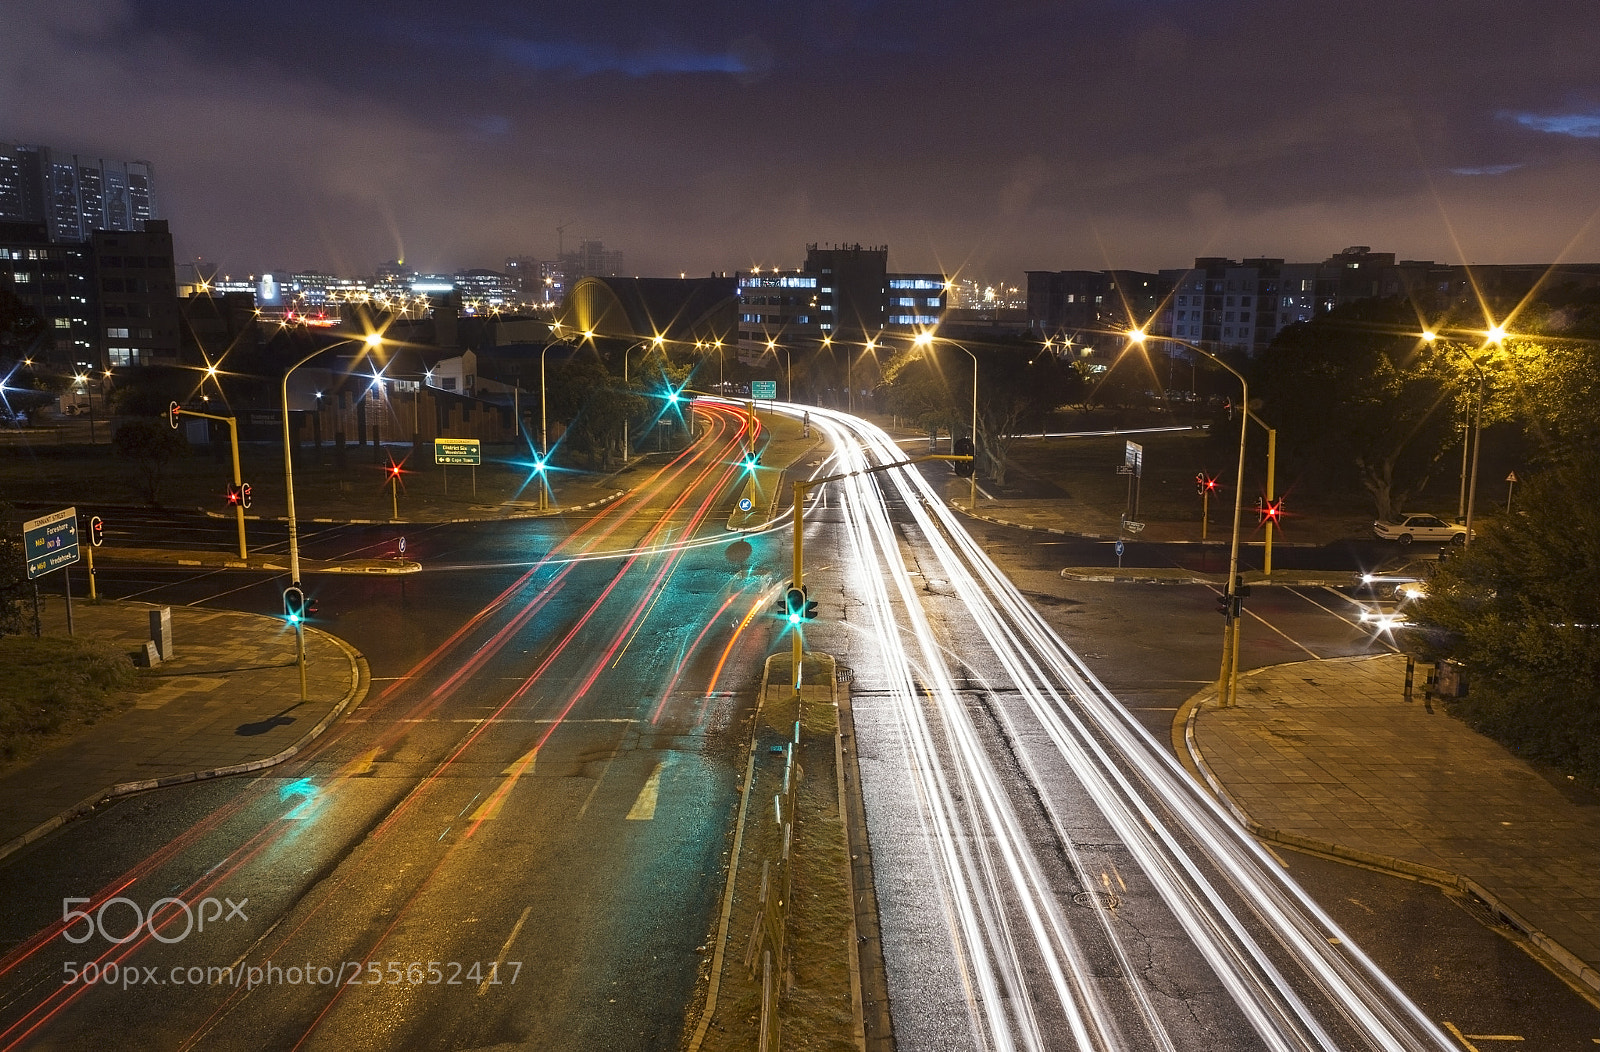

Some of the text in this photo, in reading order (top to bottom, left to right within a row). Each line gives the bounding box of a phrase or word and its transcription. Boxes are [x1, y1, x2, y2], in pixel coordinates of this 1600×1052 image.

[52, 512, 66, 520] STREET
[46, 523, 68, 535] Foreshore
[50, 552, 72, 565] Vredehoek
